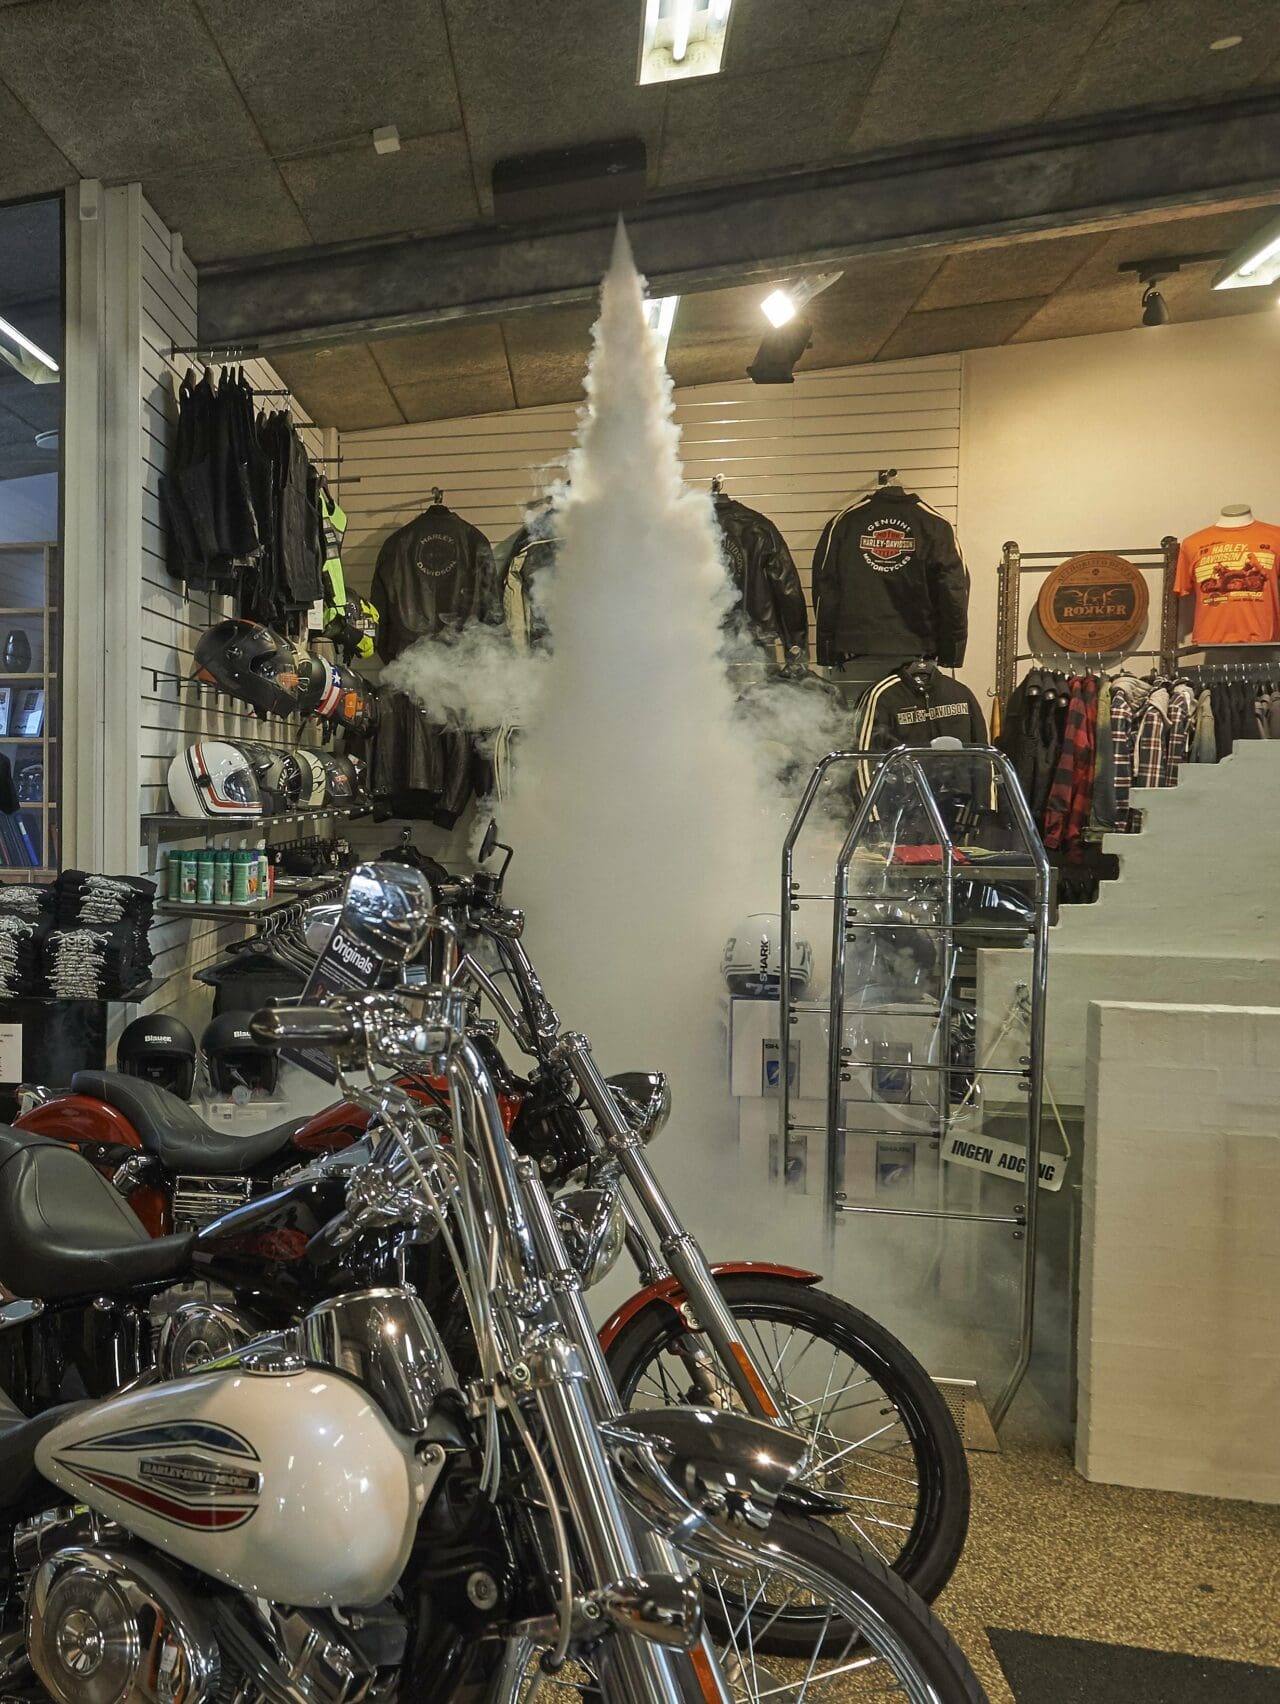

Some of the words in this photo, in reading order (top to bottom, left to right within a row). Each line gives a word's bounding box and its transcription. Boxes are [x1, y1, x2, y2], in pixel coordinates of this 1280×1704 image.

[862, 538, 913, 549] HARLEY-DAVIDSON
[863, 552, 912, 573] MOTORCYCLES
[331, 934, 374, 975] Originals
[759, 940, 769, 982] SHARK
[951, 1139, 994, 1165] INGEN
[997, 1153, 1056, 1181] ADGNG
[143, 1462, 251, 1489] HARLEY-DAVIDSON
